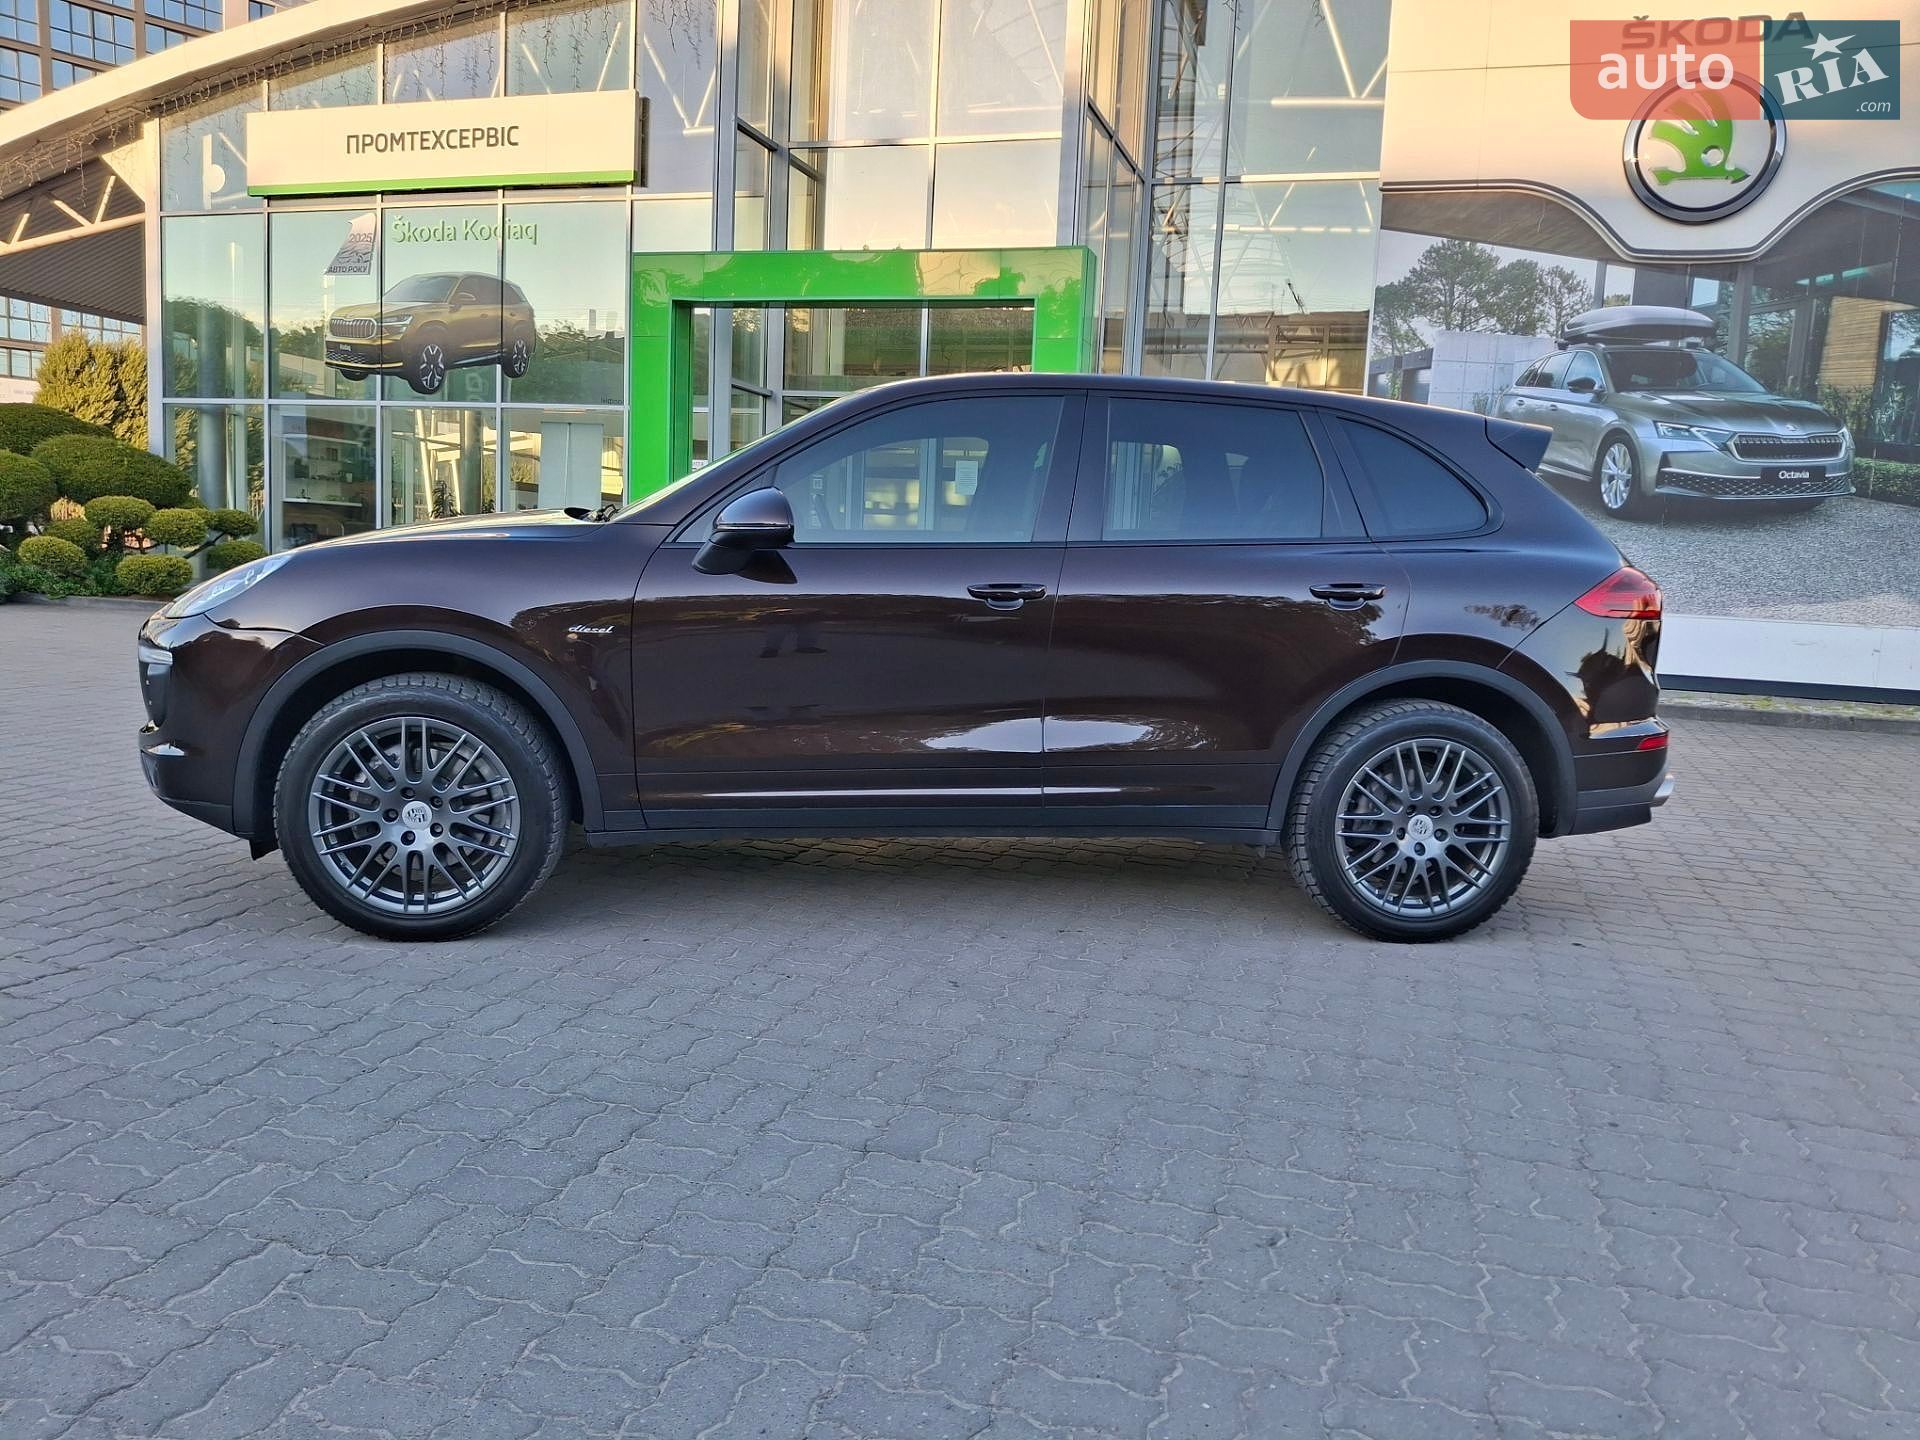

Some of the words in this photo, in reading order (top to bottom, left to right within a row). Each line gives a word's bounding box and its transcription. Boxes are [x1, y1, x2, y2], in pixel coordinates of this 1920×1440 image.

[1621, 11, 1814, 50] ŠKODA
[346, 125, 520, 154] ПРОМТЕХСЕРВІС
[349, 232, 373, 243] 2025
[391, 215, 457, 243] Škoda
[568, 624, 616, 634] diesel
